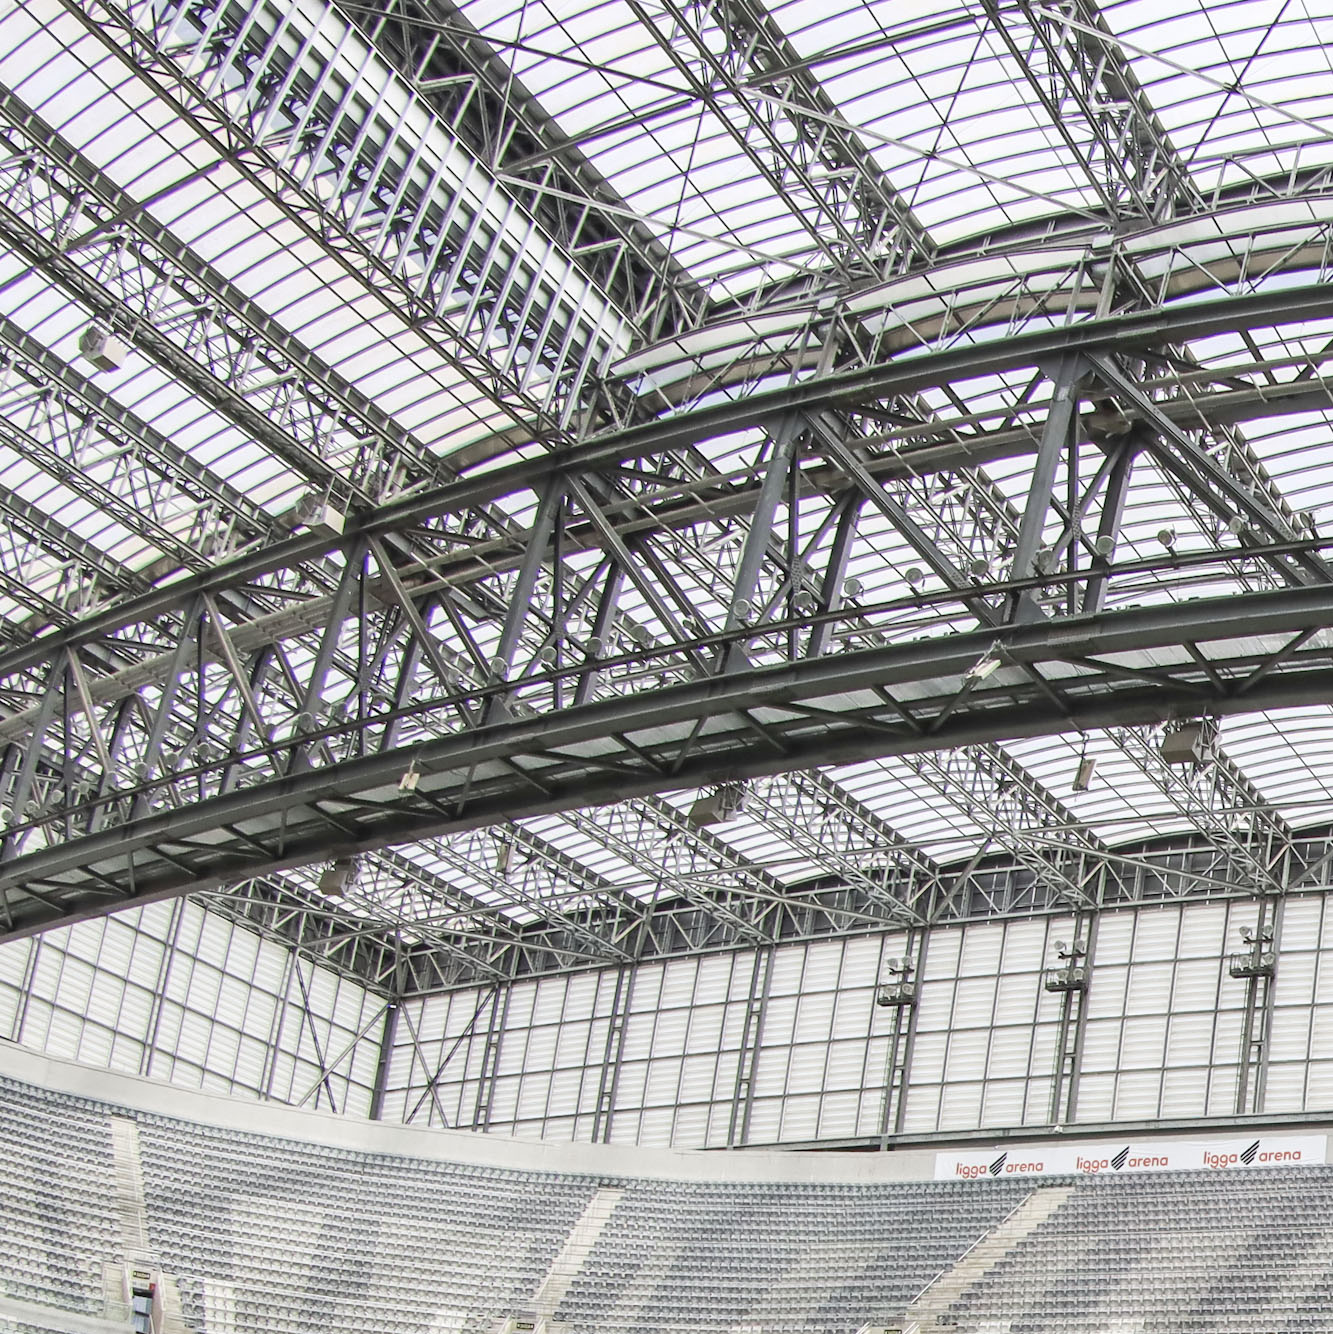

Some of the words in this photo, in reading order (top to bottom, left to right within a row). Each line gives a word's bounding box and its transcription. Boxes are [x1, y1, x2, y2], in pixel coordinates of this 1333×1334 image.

[1076, 1156, 1108, 1173] ligga
[1128, 1155, 1168, 1167] arena
[1203, 1151, 1237, 1168] ligga
[1258, 1150, 1301, 1162] arena
[956, 1162, 987, 1179] ligga
[1006, 1160, 1044, 1173] arena
